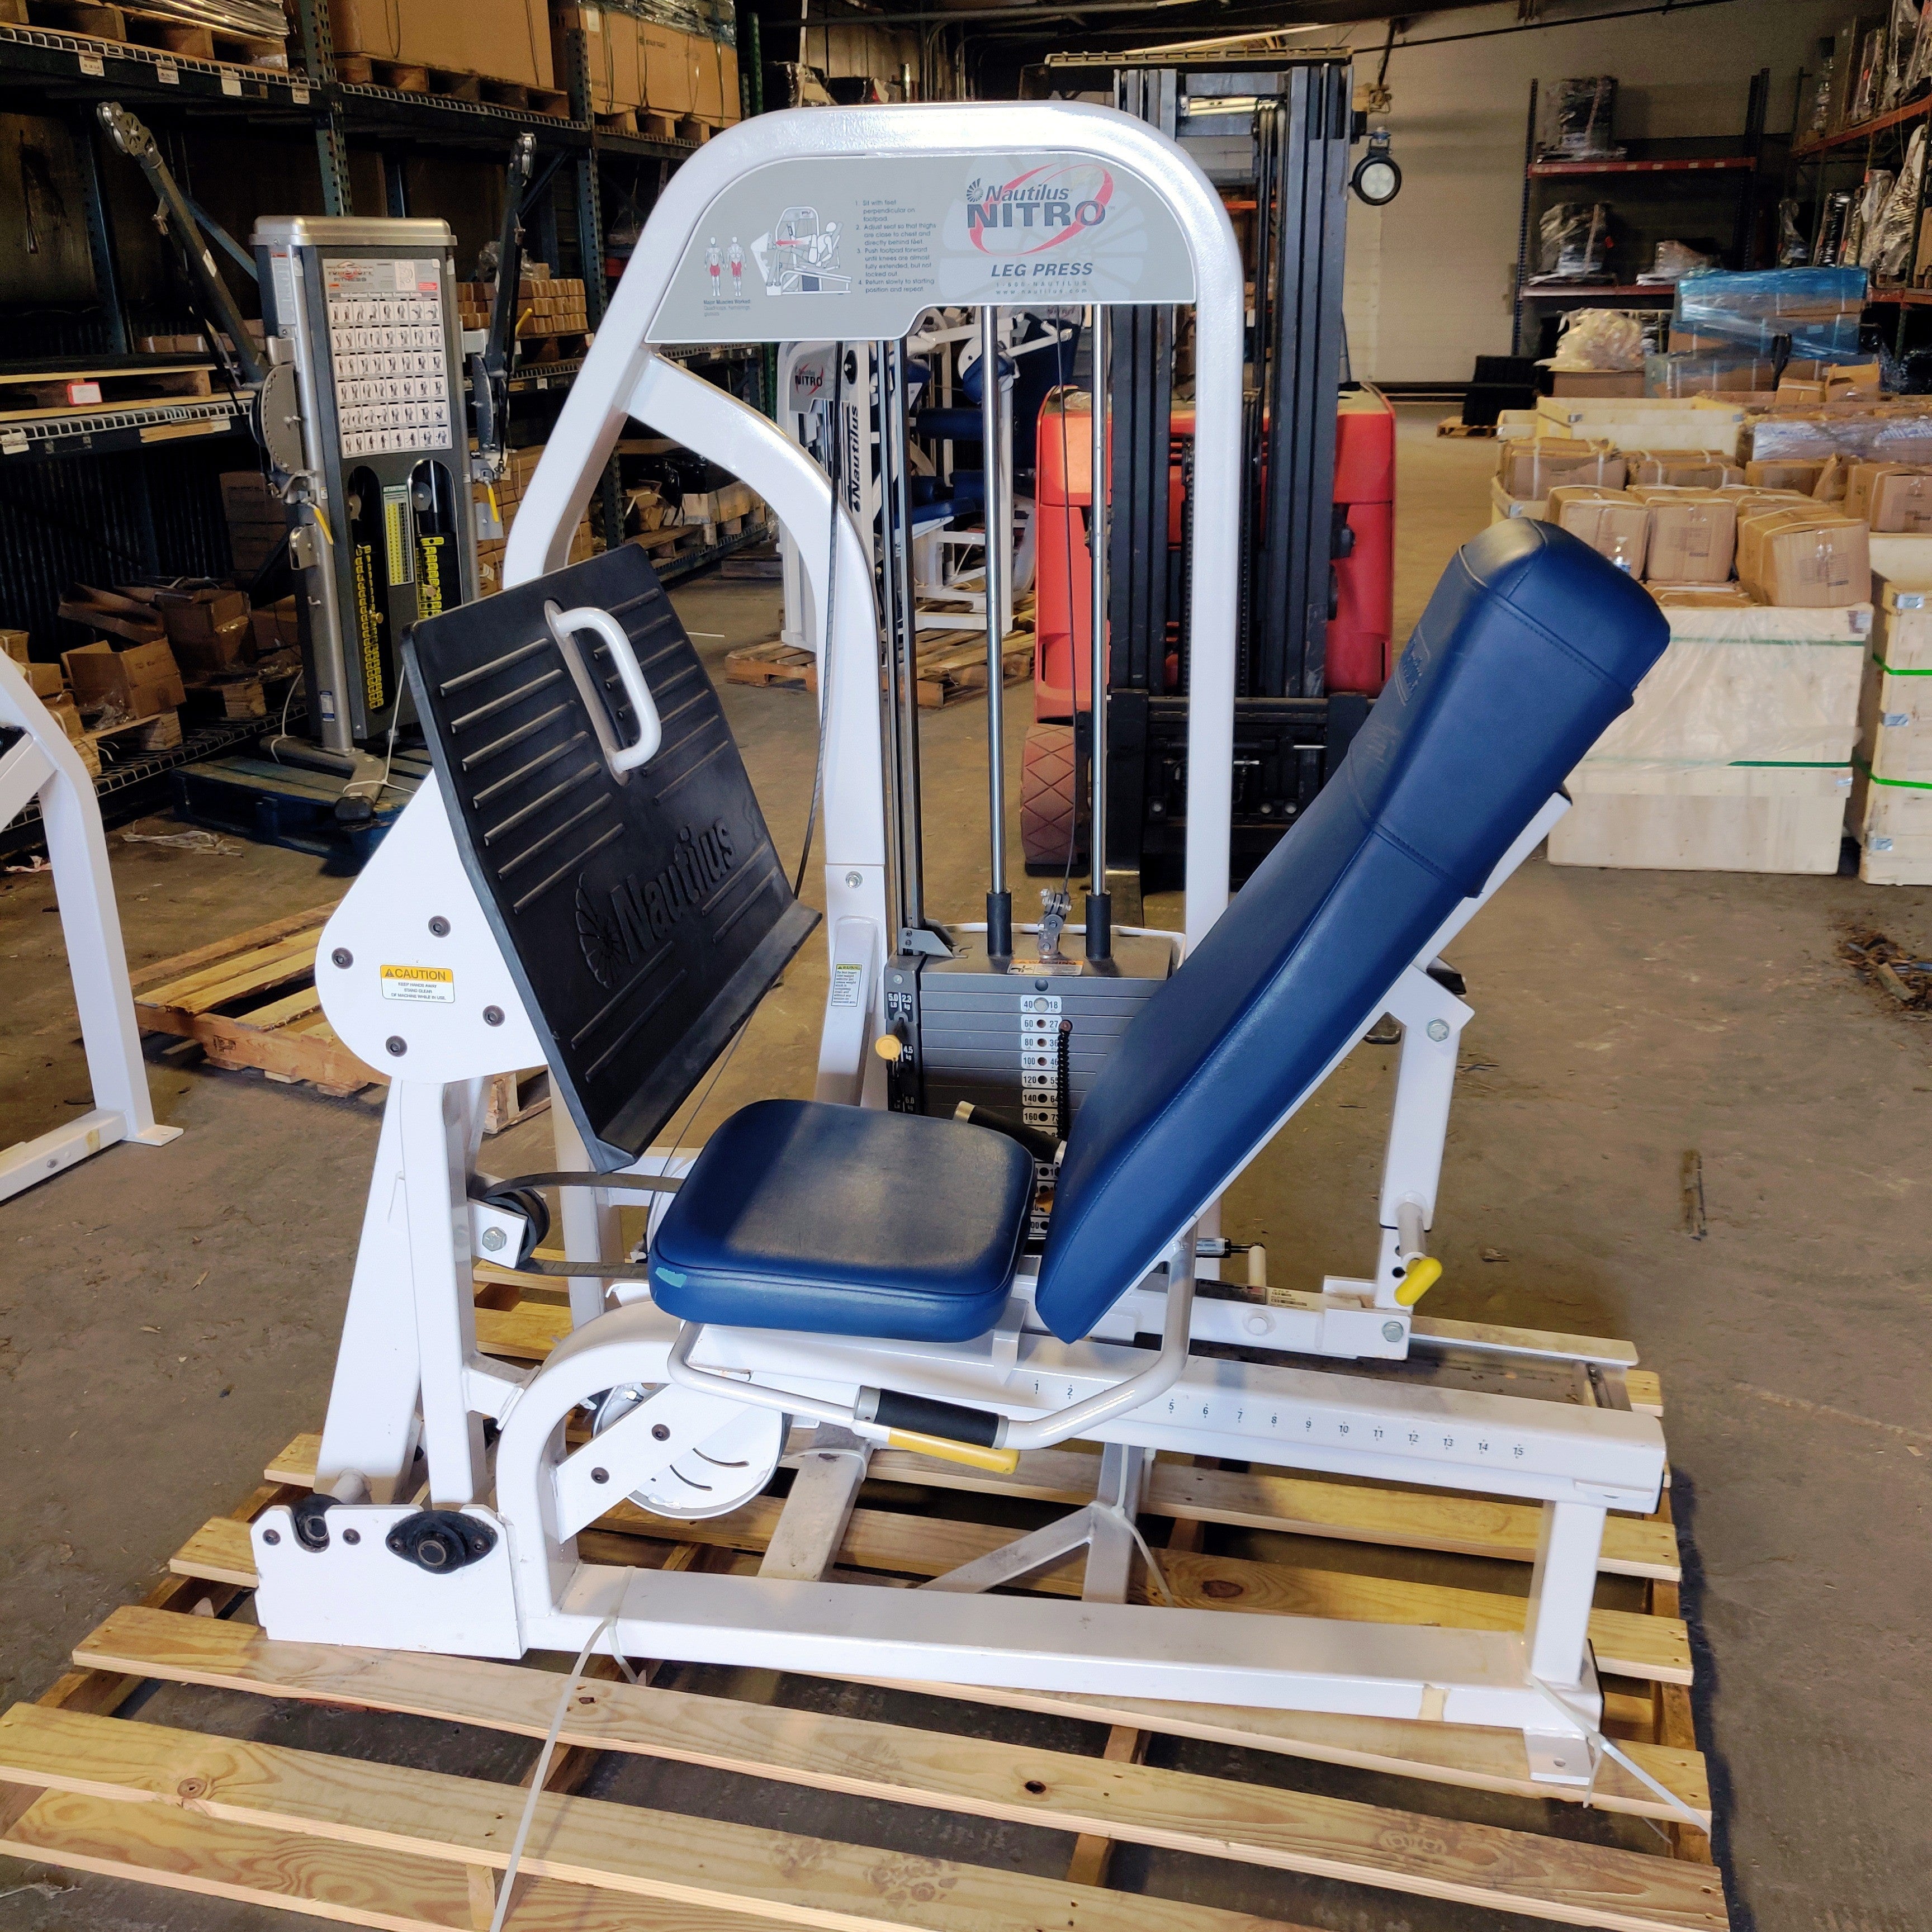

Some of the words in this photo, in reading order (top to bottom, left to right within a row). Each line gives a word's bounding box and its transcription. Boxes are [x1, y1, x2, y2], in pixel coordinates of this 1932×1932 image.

[985, 184, 1069, 201] Nautilus
[967, 200, 1105, 228] NITRO
[991, 264, 1026, 277] LEG
[1033, 263, 1093, 276] PRESS
[795, 375, 822, 387] NITRO
[851, 405, 861, 500] Nautilus
[610, 817, 736, 964] Nautilus
[395, 969, 446, 981] CAUTION
[888, 993, 898, 1002] 5.0
[902, 995, 912, 1003] 2.3
[903, 1045, 913, 1054] 4.5
[1068, 1388, 1073, 1396] 2
[1168, 1402, 1174, 1410] 5
[1202, 1406, 1209, 1415] 6
[1238, 1411, 1243, 1419] 7
[1271, 1415, 1277, 1424] 8
[1305, 1420, 1311, 1429] 9
[1339, 1425, 1348, 1433] 10
[1374, 1429, 1383, 1438] 11
[1408, 1433, 1418, 1442] 12
[1443, 1438, 1453, 1447] 13
[1478, 1442, 1488, 1451] 14
[1513, 1447, 1524, 1456] 15
